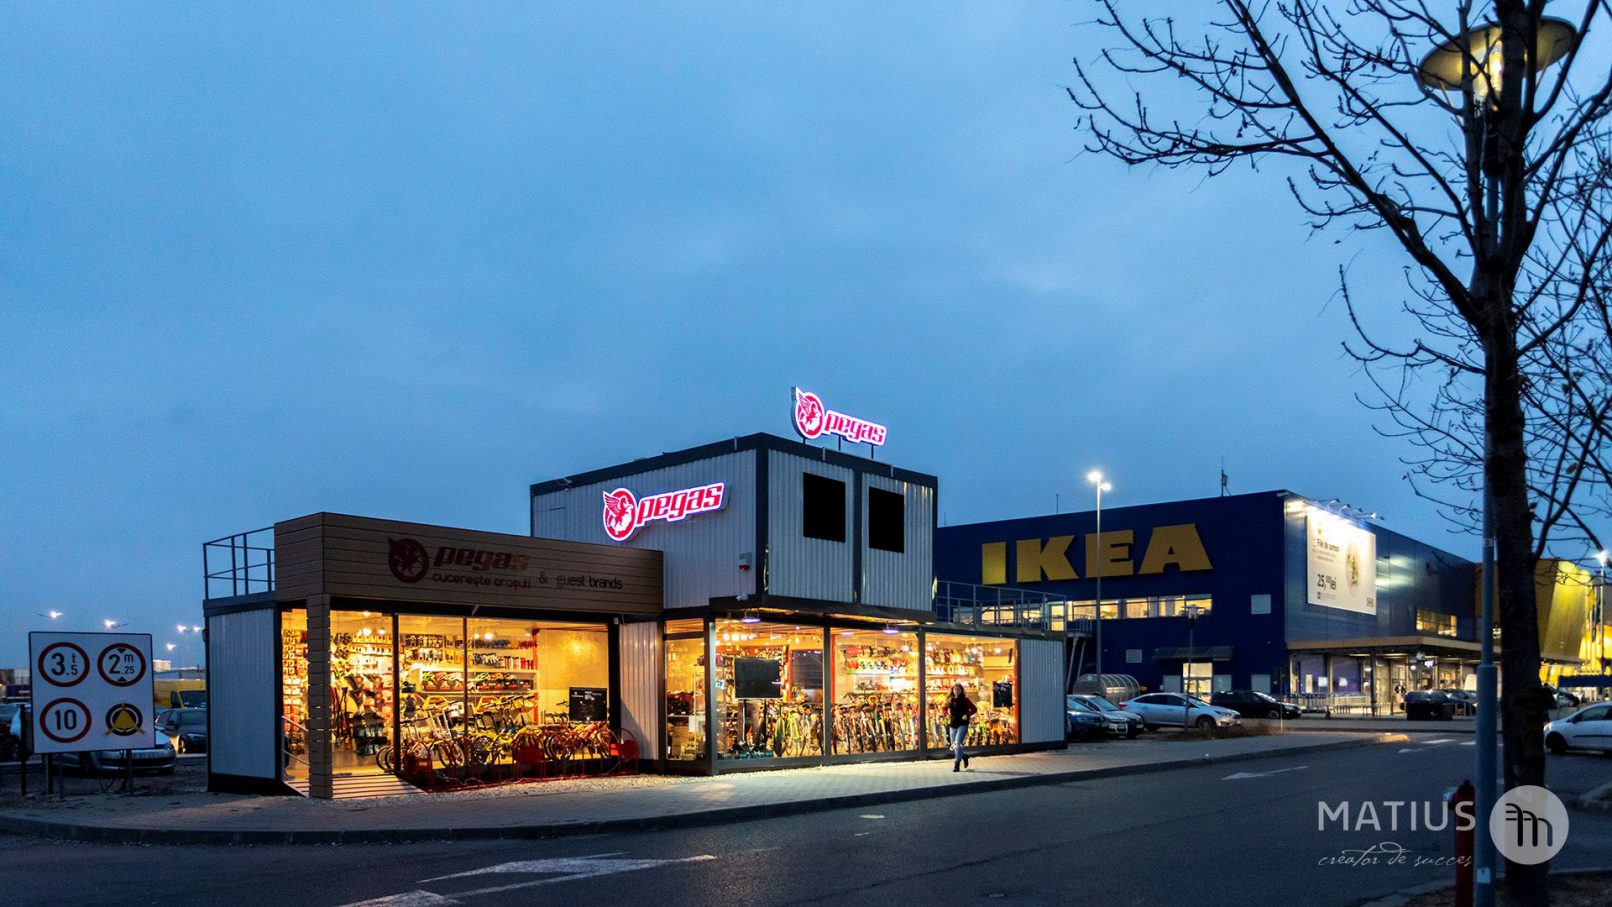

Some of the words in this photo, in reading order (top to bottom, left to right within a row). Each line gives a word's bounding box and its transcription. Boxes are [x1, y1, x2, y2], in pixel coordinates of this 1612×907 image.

[824, 412, 886, 445] pegas
[636, 483, 724, 524] pegas
[434, 546, 529, 571] pegas
[981, 523, 1214, 586] IKEA
[539, 571, 548, 584] &
[557, 574, 586, 589] guest
[589, 575, 624, 590] brands
[54, 709, 77, 731] 10
